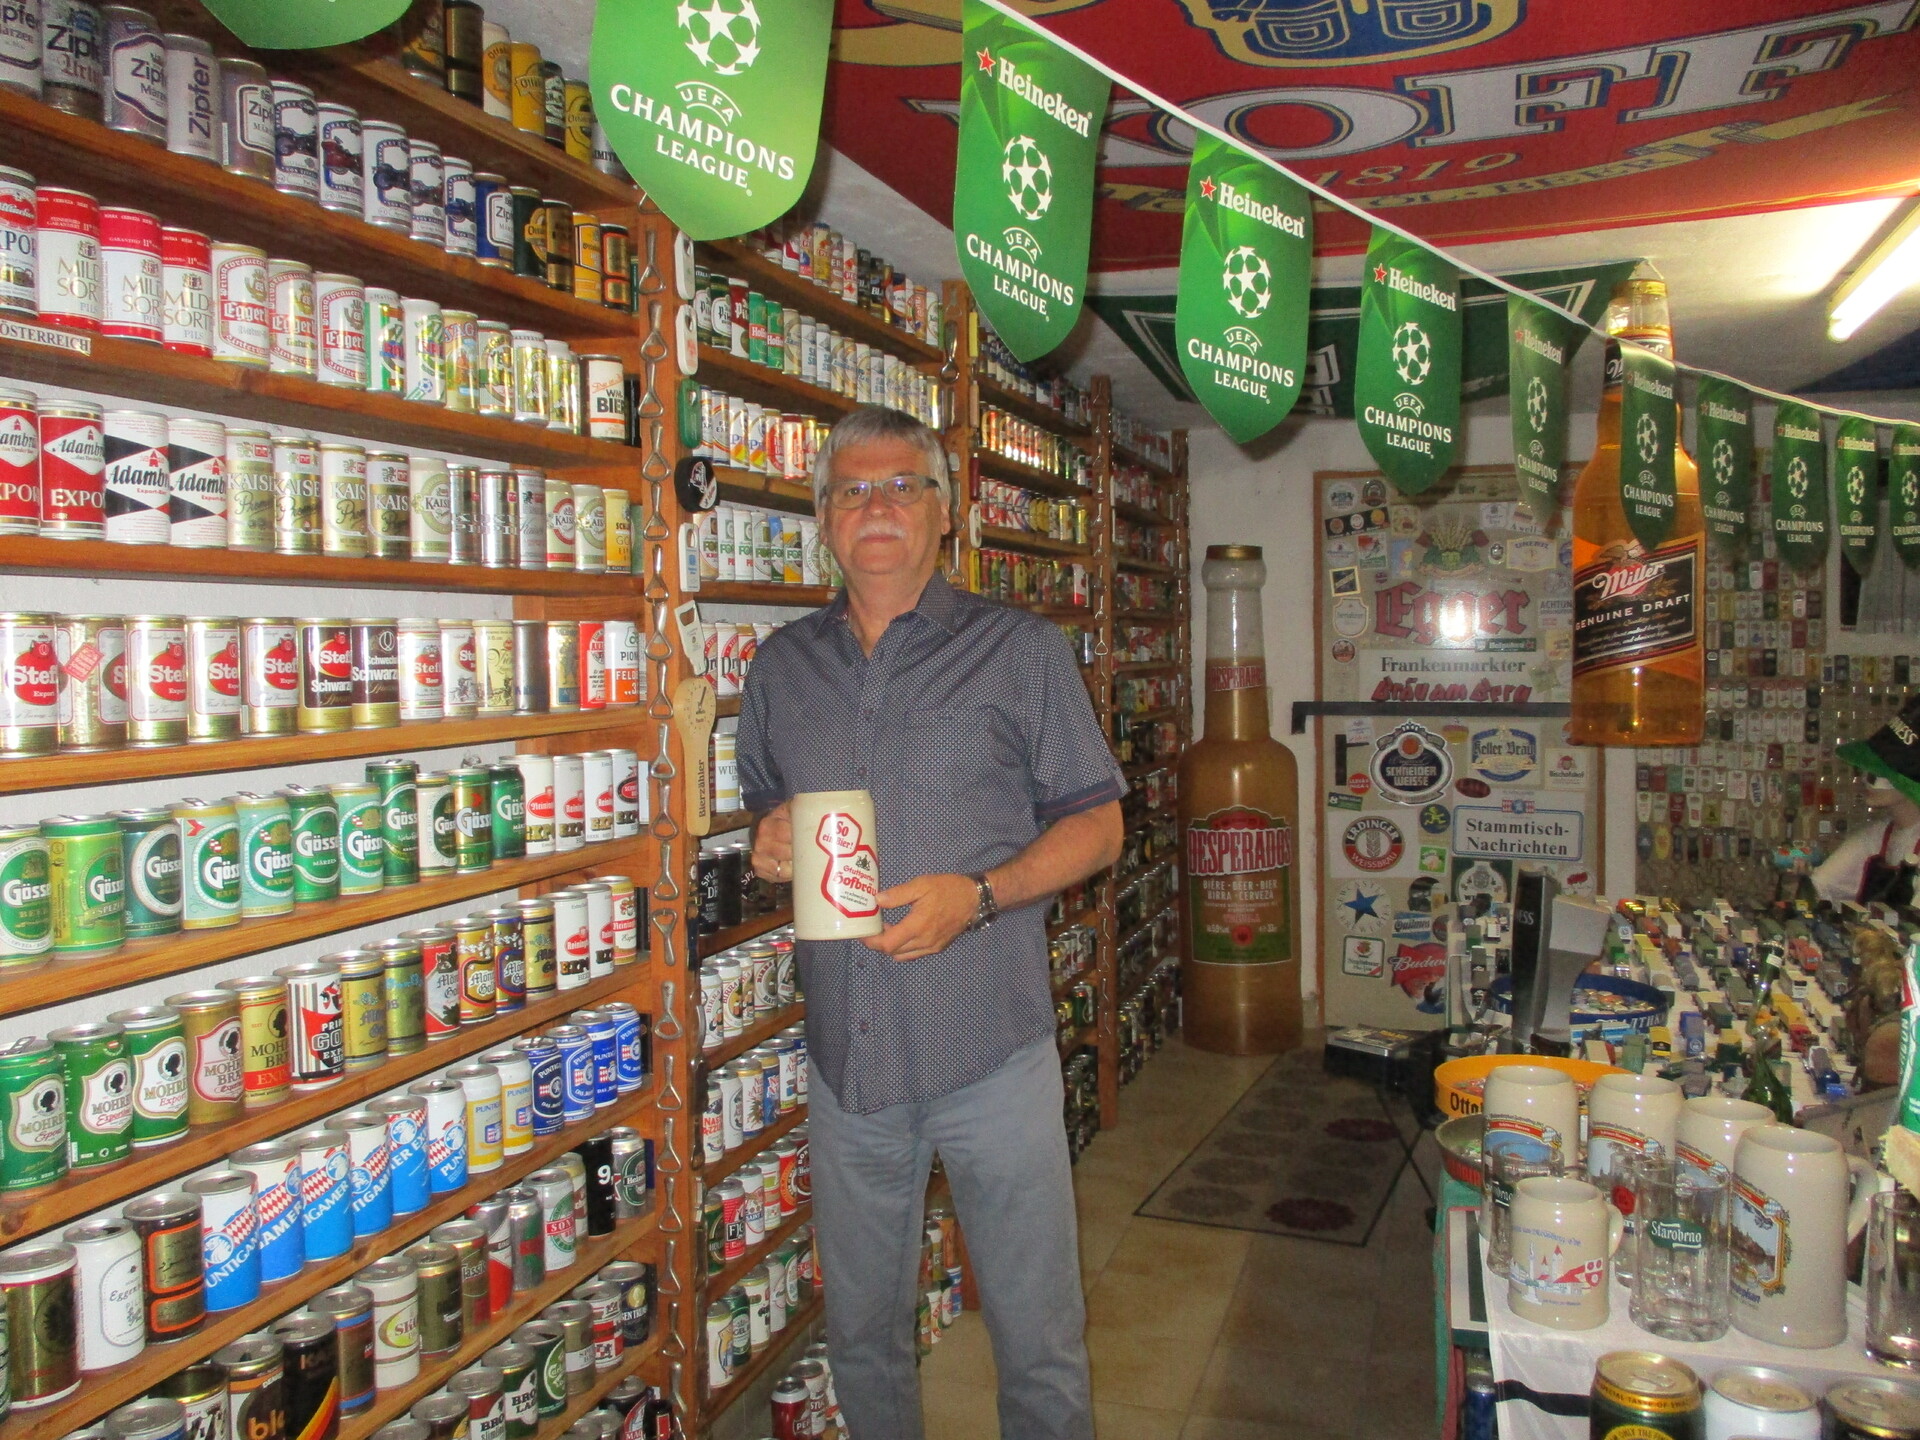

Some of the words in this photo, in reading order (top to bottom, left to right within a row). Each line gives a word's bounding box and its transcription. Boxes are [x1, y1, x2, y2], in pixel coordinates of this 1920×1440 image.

[188, 56, 212, 141] Zipfer
[680, 87, 734, 123] UEFA
[999, 57, 1090, 138] Heineken
[610, 84, 794, 180] CHAMPIONS
[656, 134, 749, 188] LEAGUE
[496, 206, 513, 222] Zip
[1218, 182, 1305, 239] Heineken
[1006, 233, 1038, 260] UEFA
[966, 233, 1074, 306] CHAMPIONS
[57, 278, 99, 301] SOR
[993, 274, 1048, 316] LEAGUE
[1388, 268, 1456, 312] Heineken
[123, 296, 162, 316] SOR
[163, 308, 211, 331] SORT
[0, 322, 89, 354] ÖSTERREICH
[1225, 331, 1258, 352] UEFA
[1524, 329, 1562, 365] Heineken
[1187, 338, 1294, 388] CHAMPIONS
[1215, 370, 1268, 400] LEAGUE
[1633, 372, 1673, 400] Heineken
[1395, 397, 1421, 412] UEFA
[1709, 402, 1747, 425] Heineken
[1364, 406, 1452, 443] CHAMPIONS
[1387, 433, 1432, 455] LEAGUE
[1518, 454, 1558, 484] CHAMPIONS
[331, 482, 365, 500] KAIS
[1528, 476, 1548, 494] LEAGUE
[1624, 485, 1674, 508] CHAMPIONS
[51, 488, 104, 508] EXPO
[374, 495, 408, 513] KAIS
[425, 497, 450, 511] KAIS
[1635, 505, 1661, 518] LEAGUE
[1704, 506, 1745, 524] CHAMPIONS
[1776, 519, 1824, 533] CHAMPIONS
[1787, 534, 1812, 543] LEAGUE
[1593, 563, 1665, 601] Miller
[1541, 601, 1572, 611] ACHTUN
[1575, 607, 1633, 631] GENUINE
[1642, 594, 1690, 613] DRAFT
[264, 659, 298, 675] Stef
[320, 650, 352, 664] Stef
[1381, 657, 1526, 673] Frankenmarkter
[208, 662, 239, 680] Ste
[1208, 666, 1264, 691] DESPERADOS
[1385, 766, 1437, 777] SCHNEIDER
[1393, 777, 1429, 787] WEISSE
[698, 759, 706, 818] Bierzähler
[496, 795, 524, 821] Gös
[386, 808, 416, 832] Göss
[434, 816, 455, 835] Göss
[456, 808, 492, 838] Göss
[836, 820, 849, 837] So
[1346, 819, 1400, 841] ERDINGER
[1466, 818, 1570, 837] Stammtisch-
[296, 830, 339, 858] Göss
[347, 831, 383, 859] Göss
[1188, 827, 1291, 875] DESPERADOS
[1467, 837, 1568, 856] Nachrichten
[146, 855, 182, 878] Göss
[203, 856, 241, 889] Göss
[254, 847, 293, 879] Göss
[3, 878, 50, 906] Göss
[89, 875, 124, 903] Göss
[1208, 890, 1232, 900] BIRRA
[1239, 889, 1273, 900] CERVEZA
[1233, 880, 1253, 890] BEER
[312, 1031, 342, 1052] GO
[323, 1049, 343, 1061] EXP
[1450, 1093, 1484, 1115] Otta
[1650, 1220, 1702, 1244] Starobrno
[512, 1391, 536, 1407] BRO
[481, 1413, 503, 1430] BRO
